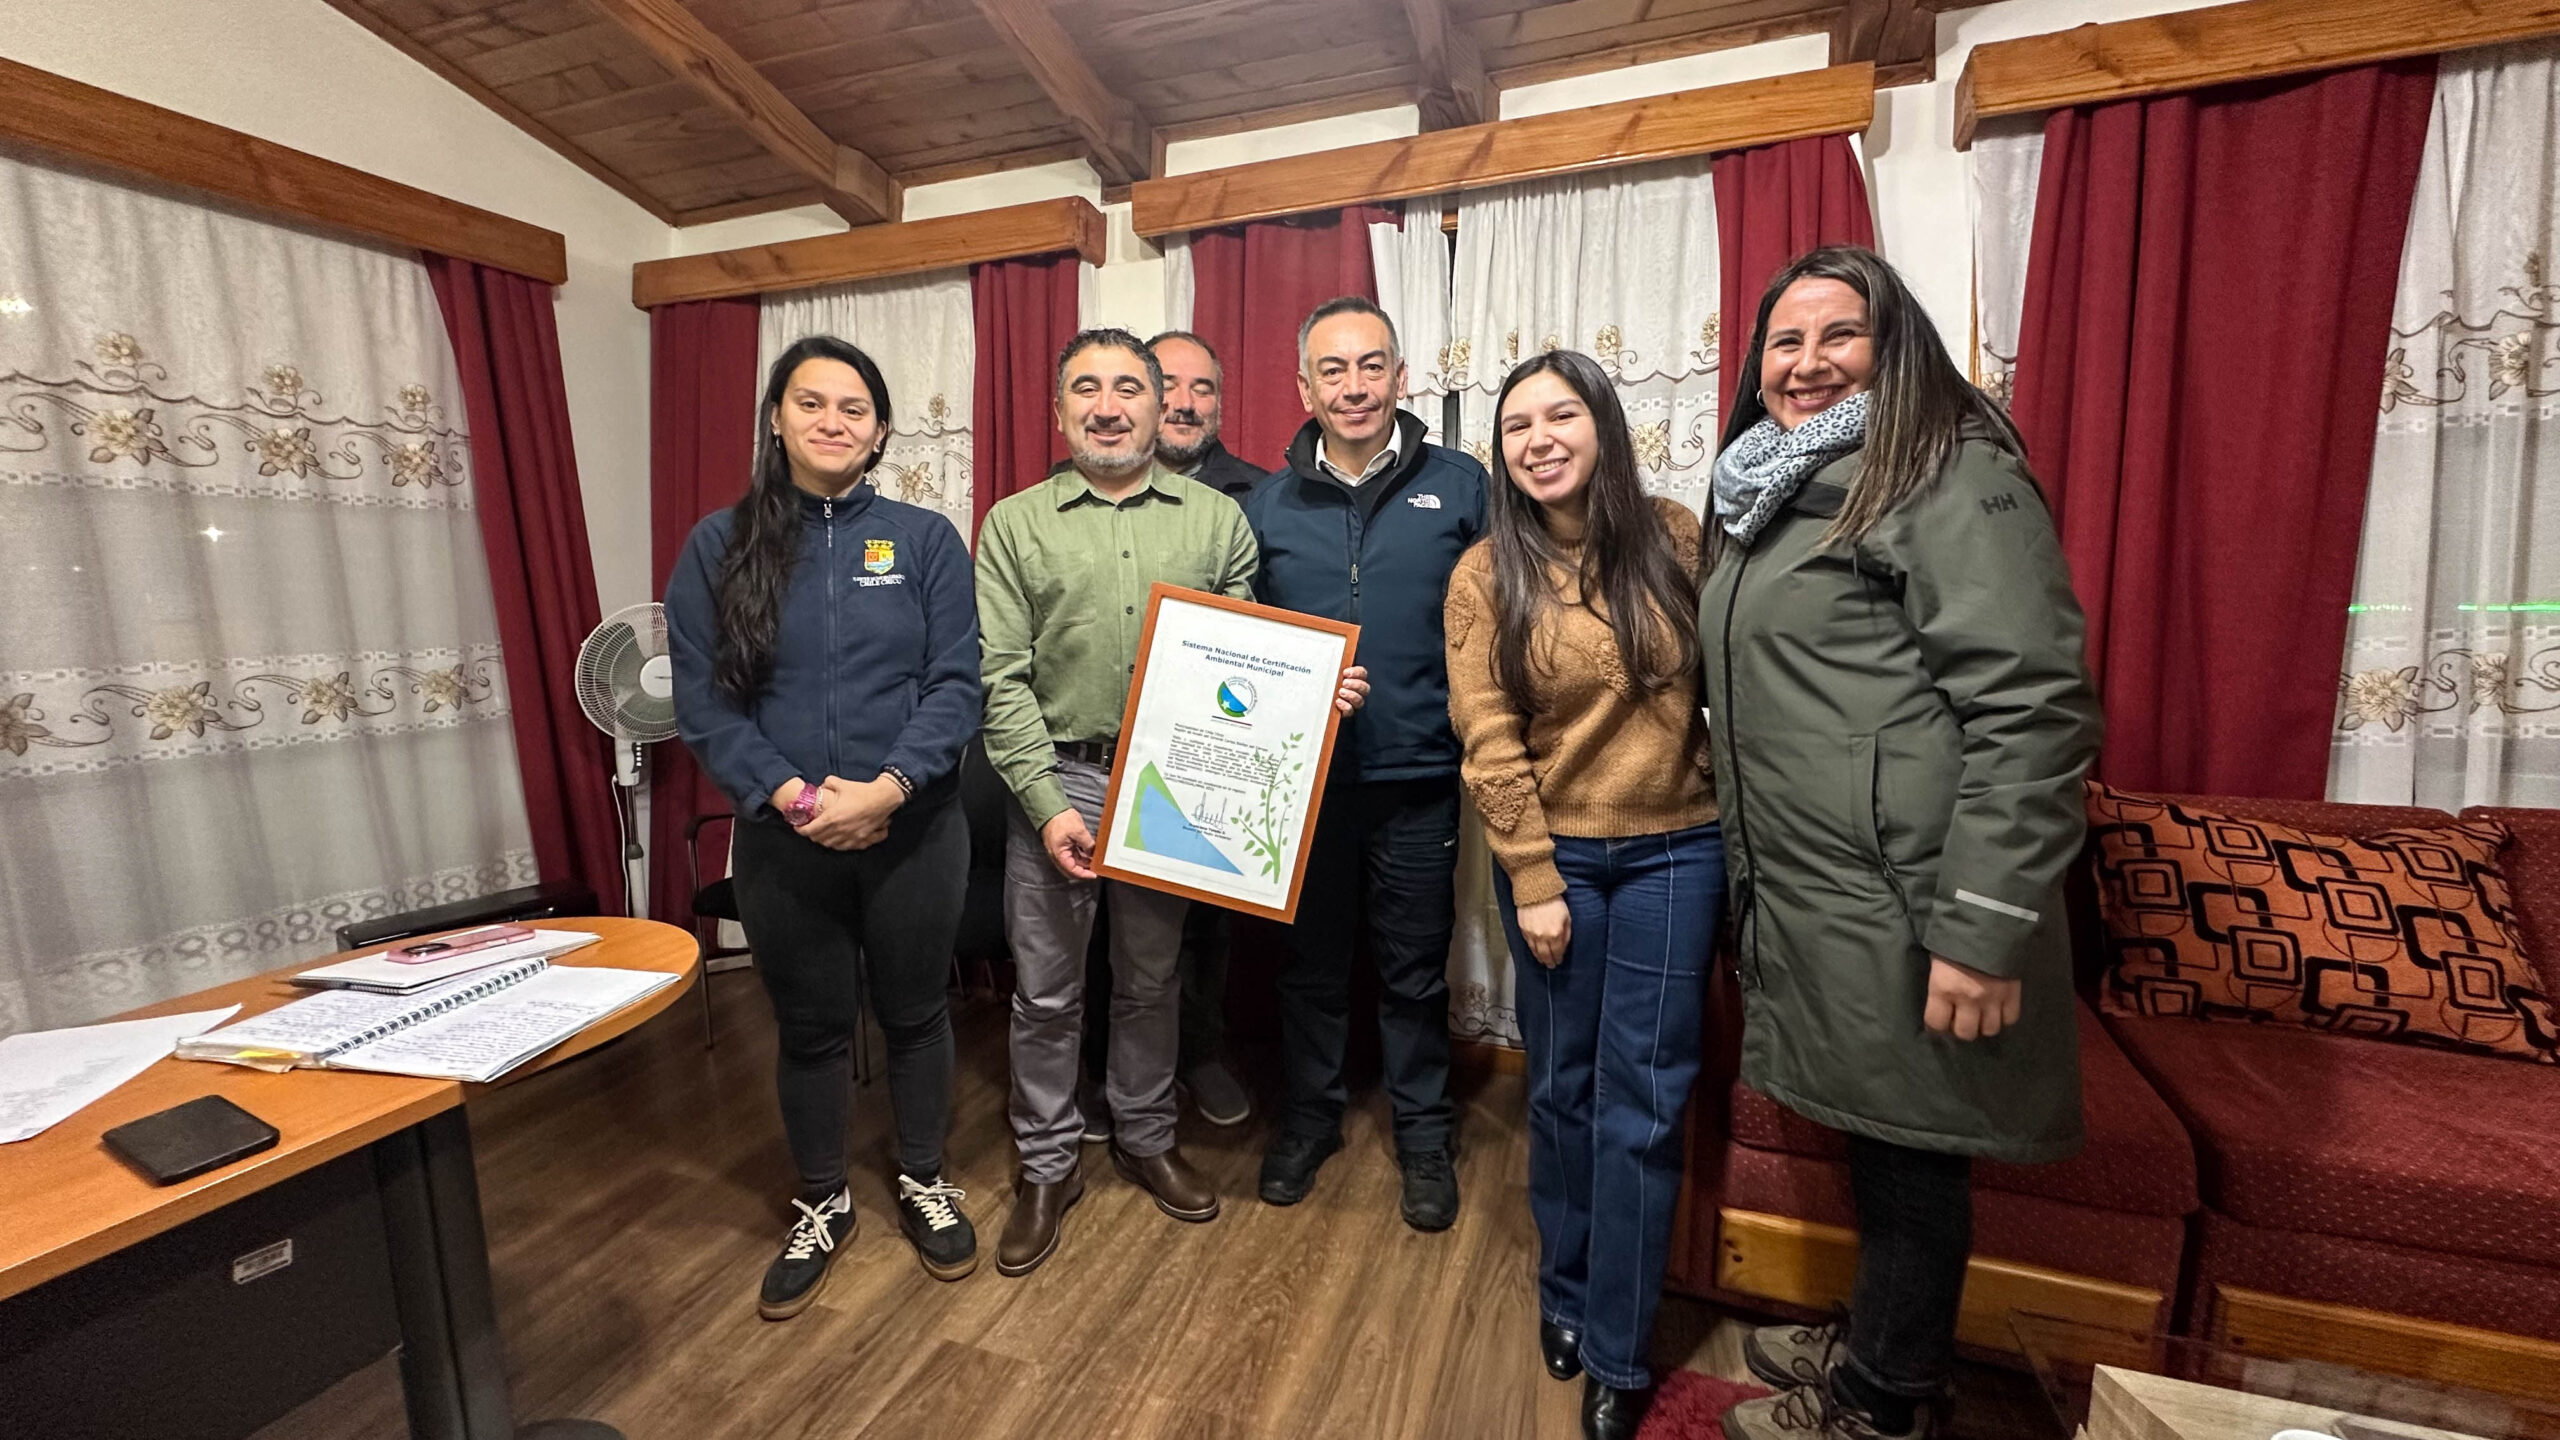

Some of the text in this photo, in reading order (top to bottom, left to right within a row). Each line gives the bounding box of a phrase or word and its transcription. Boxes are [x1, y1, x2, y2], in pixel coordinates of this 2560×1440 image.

[1980, 492, 2018, 515] HH
[1182, 640, 1311, 674] Sistema Nacional de Certificación
[1205, 654, 1284, 677] Ambiental Municipal
